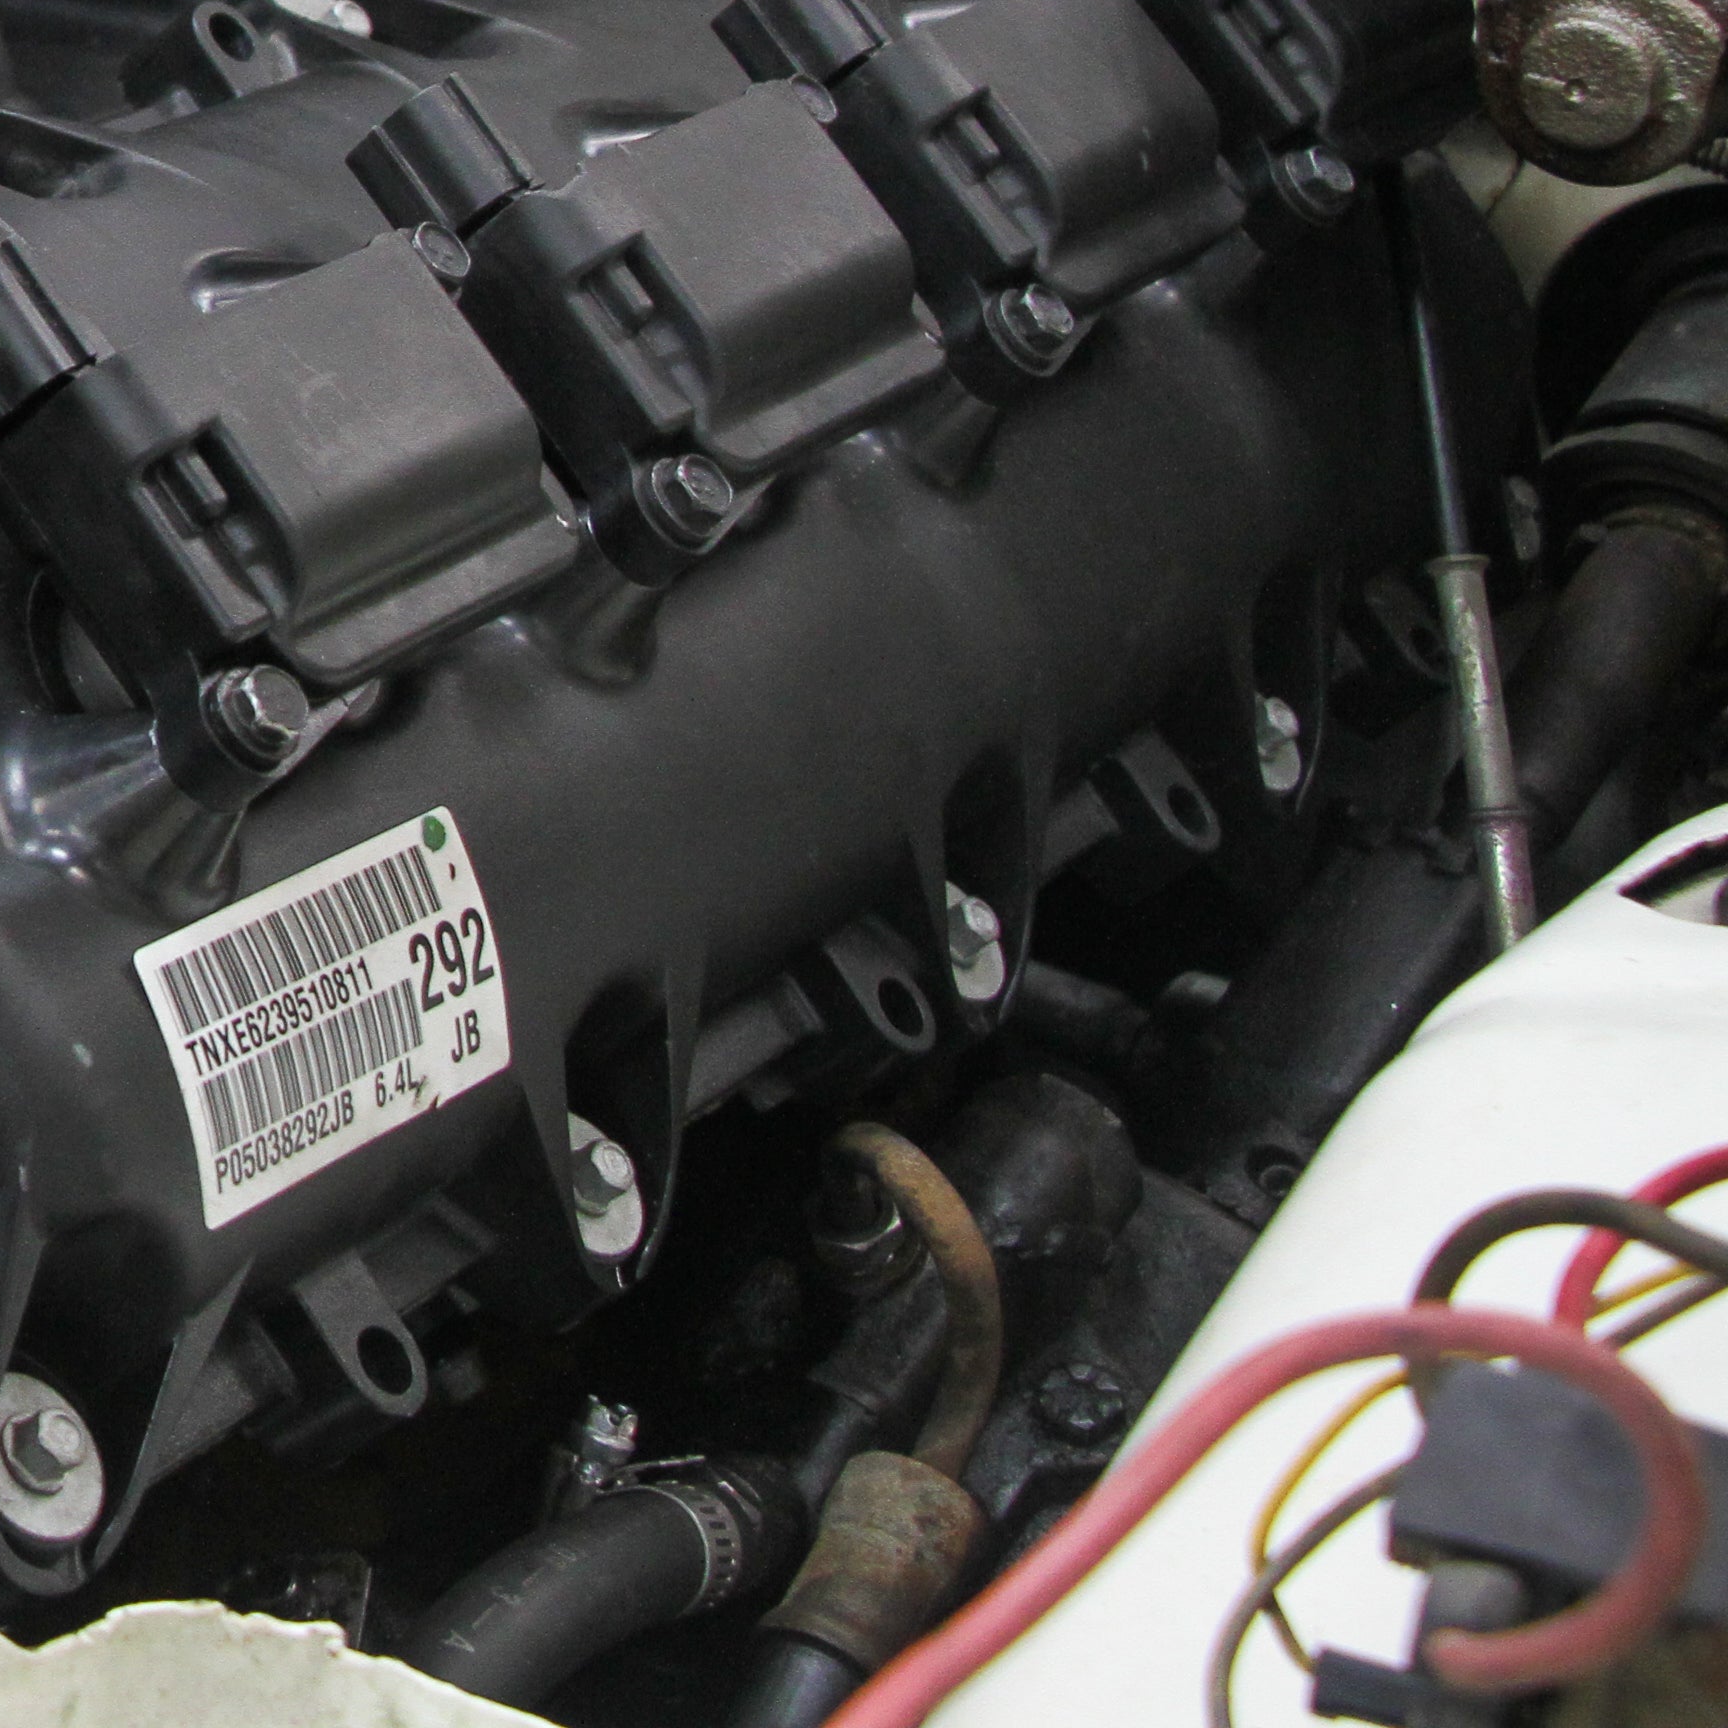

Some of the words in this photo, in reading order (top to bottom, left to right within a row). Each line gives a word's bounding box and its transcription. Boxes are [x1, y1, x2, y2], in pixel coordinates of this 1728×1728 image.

[185, 955, 373, 1076] TNXE6239510811
[409, 907, 495, 1013] 292
[451, 1009, 481, 1063] JB
[214, 1090, 355, 1195] P05038292JB
[375, 1057, 420, 1108] 6.4L
